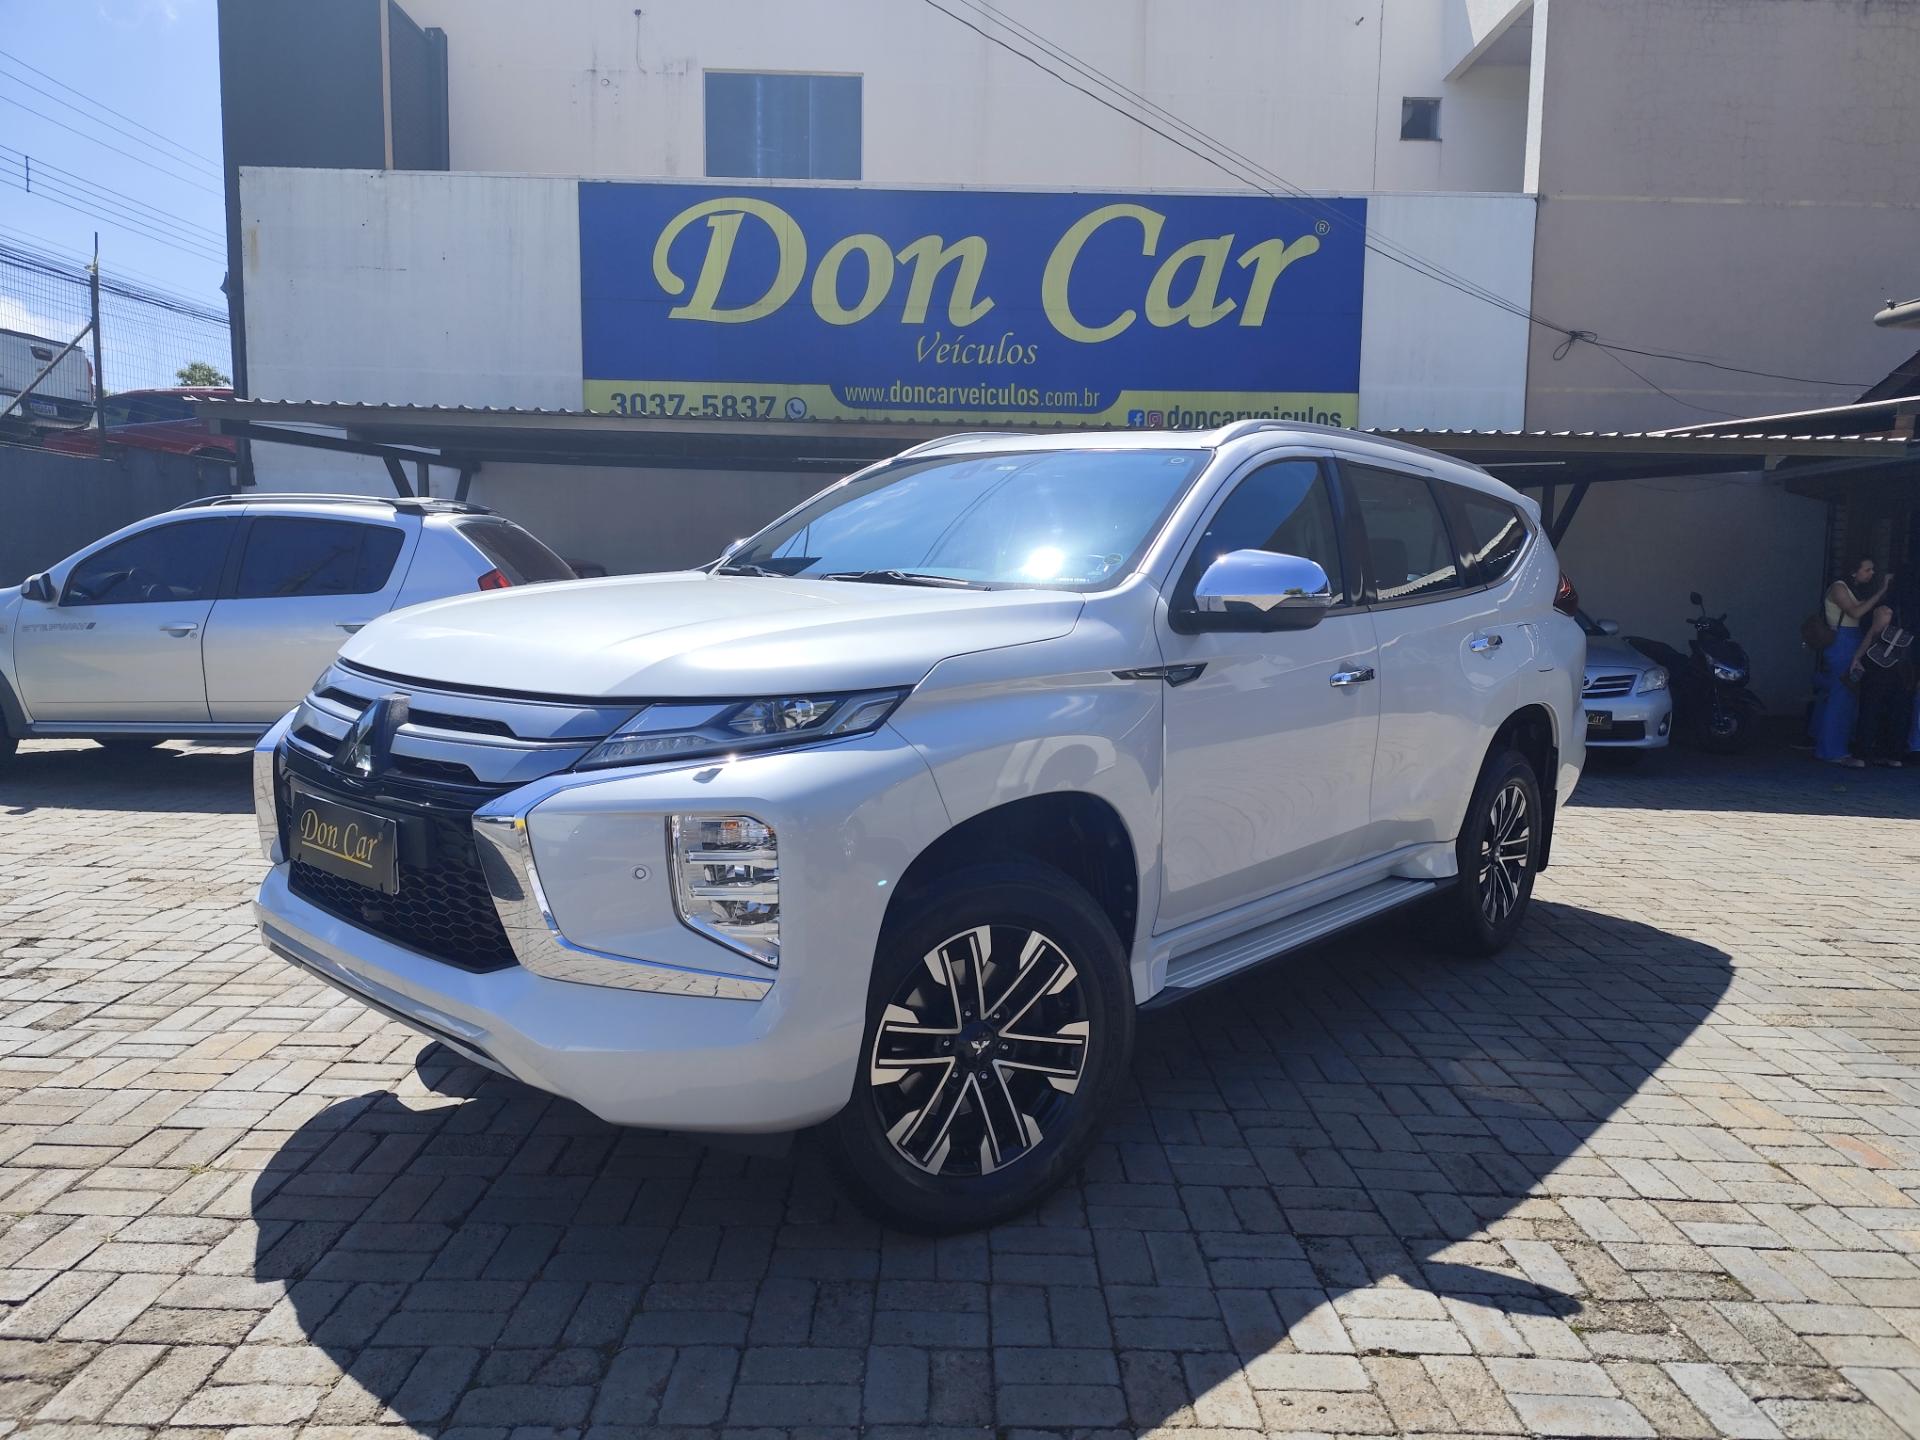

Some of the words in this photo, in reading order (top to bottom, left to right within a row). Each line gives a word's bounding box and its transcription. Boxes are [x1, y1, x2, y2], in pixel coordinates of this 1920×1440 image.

[652, 197, 996, 327] Don
[1041, 203, 1321, 344] Car
[916, 331, 1039, 365] Veículos
[611, 392, 777, 419] 3037-5837
[844, 379, 1101, 407] www.doncarveiculos.com.br
[300, 808, 338, 849] Don
[343, 823, 378, 861] Car
